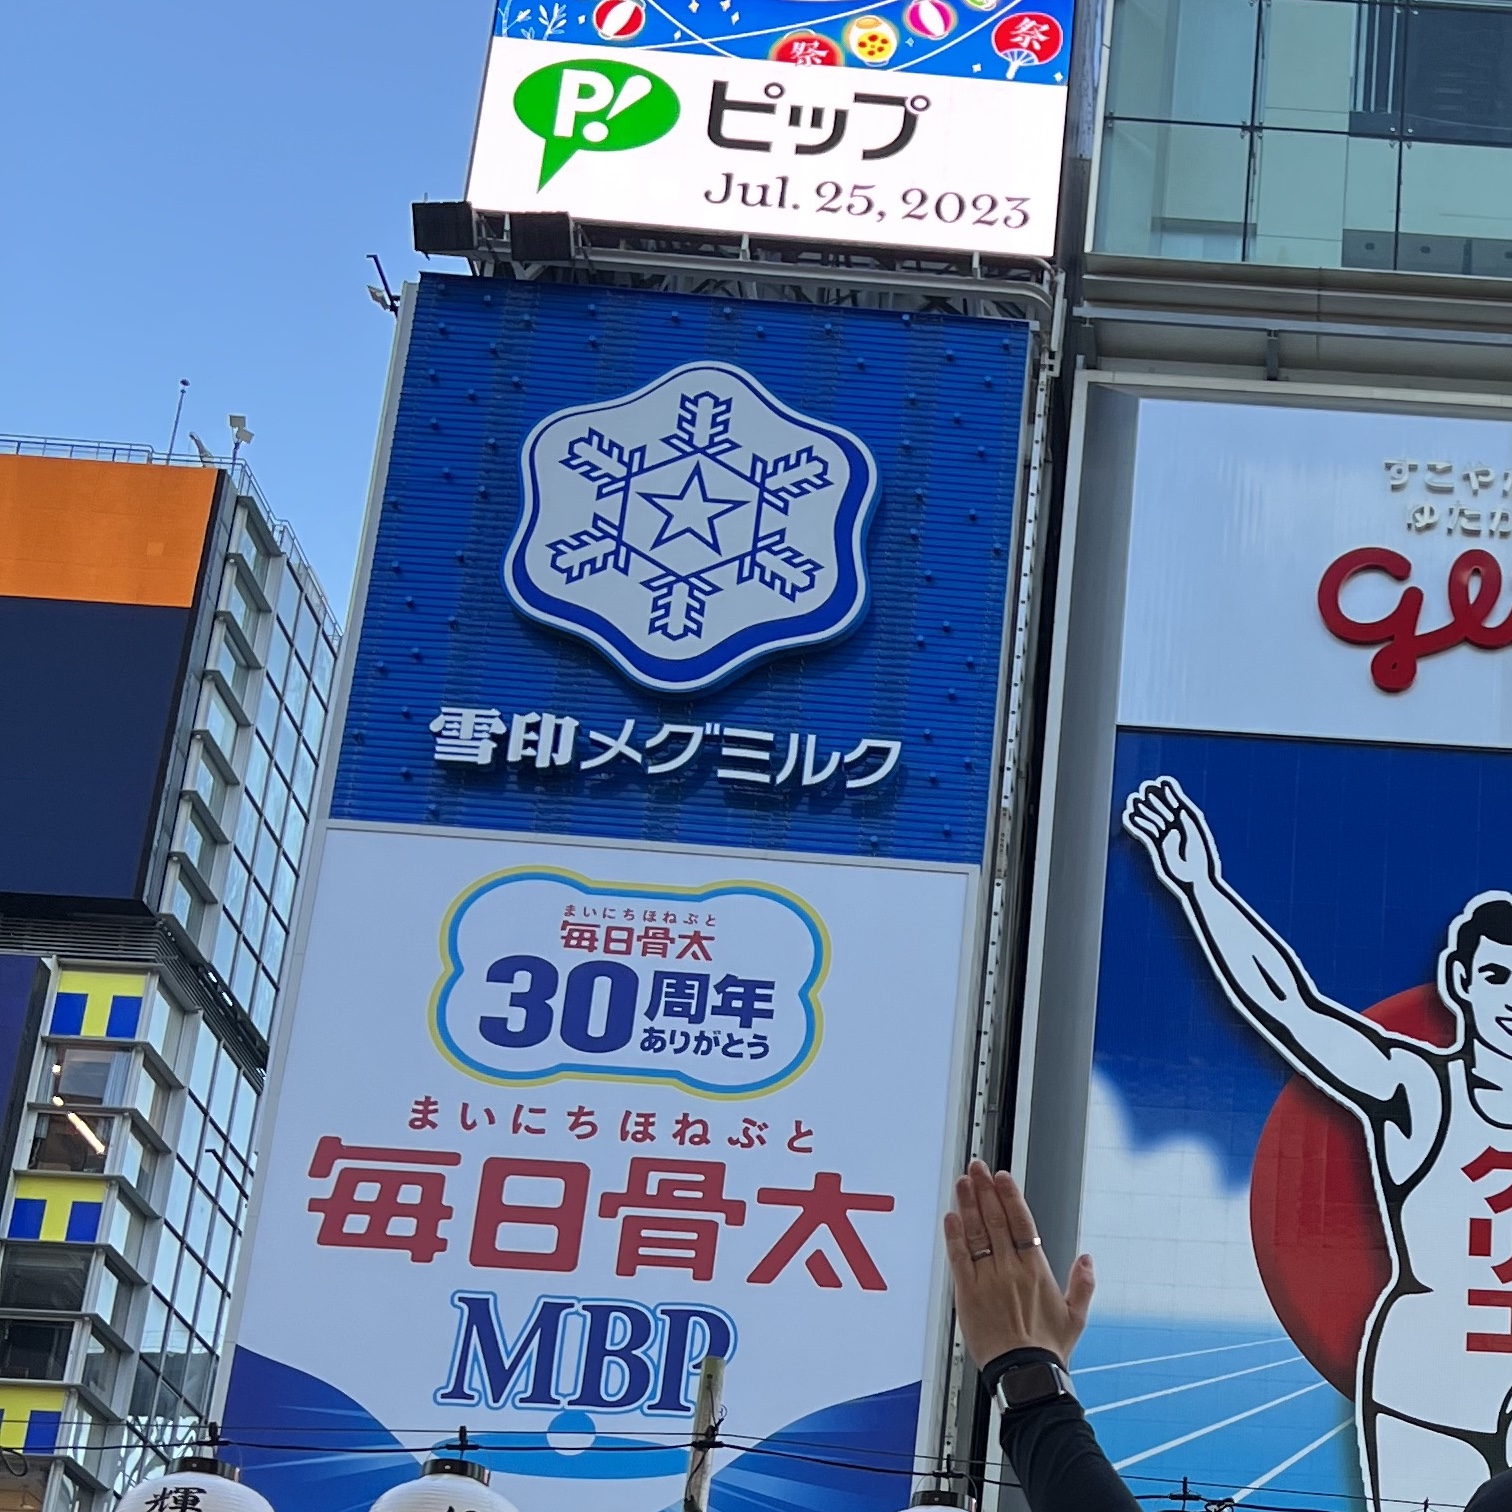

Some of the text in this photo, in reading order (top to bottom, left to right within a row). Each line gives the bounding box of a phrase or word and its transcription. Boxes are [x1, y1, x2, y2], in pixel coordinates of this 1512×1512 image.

[1008, 16, 1052, 51] 祭
[705, 78, 933, 162] ピップ
[703, 171, 1032, 230] Jul. 25, 2023
[428, 705, 903, 790] 雪印メグミルク
[560, 919, 717, 963] 毎日骨太
[562, 903, 718, 929] まいにちほねぶと
[639, 1026, 772, 1061] ありがとう
[406, 1094, 816, 1155] まいにちほねぶと
[306, 1135, 896, 1292] 毎日骨太
[432, 1288, 738, 1419] MBP
